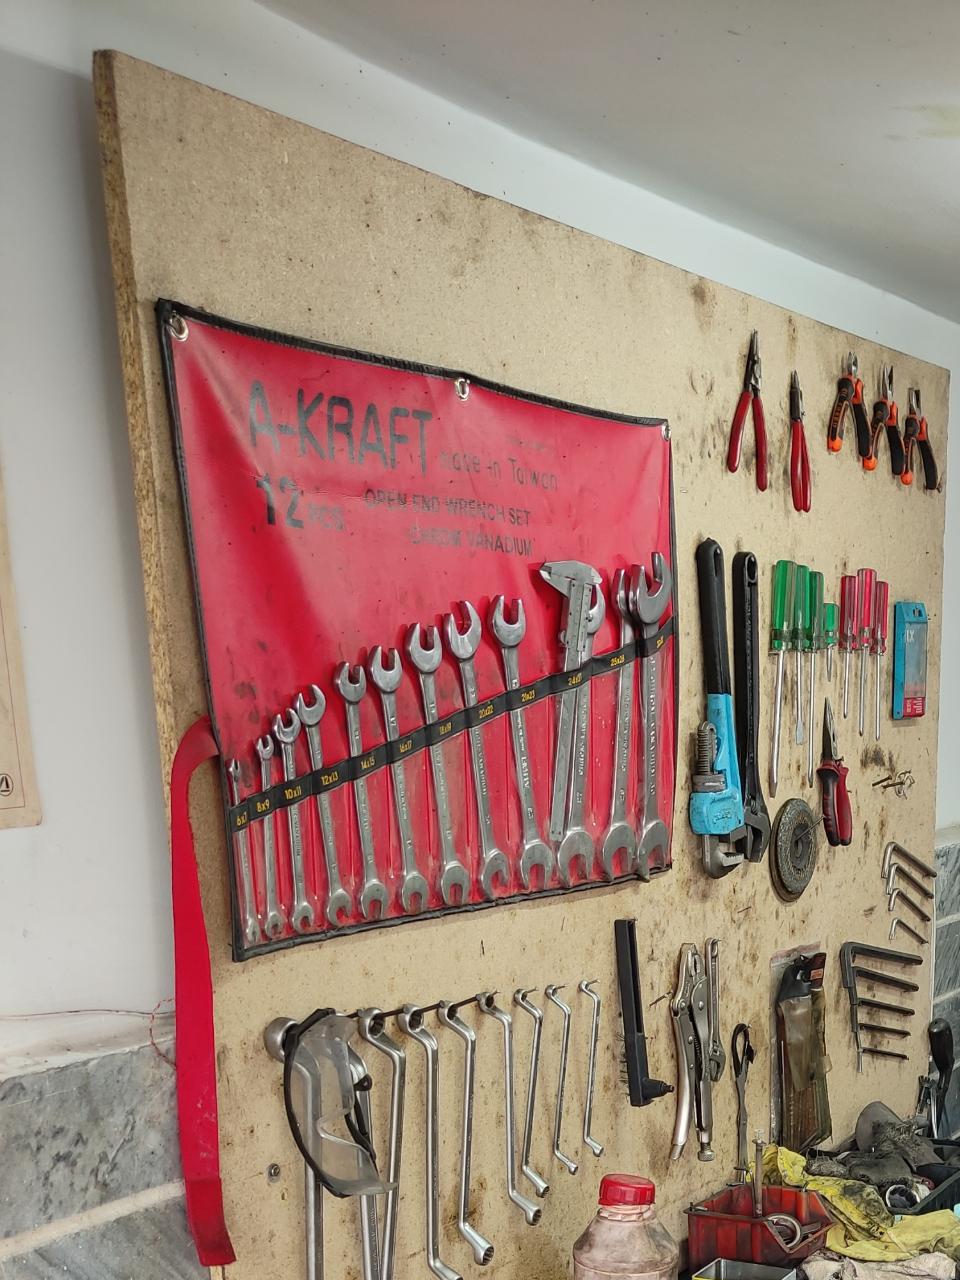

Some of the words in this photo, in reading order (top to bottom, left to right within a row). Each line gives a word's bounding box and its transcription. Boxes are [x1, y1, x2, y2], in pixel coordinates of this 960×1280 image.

[249, 379, 433, 476] A-KRAFT
[508, 457, 558, 494] Taiwan
[256, 472, 304, 527] 12
[364, 487, 407, 509] OPEN
[412, 493, 440, 513] END
[445, 497, 504, 520] WRENCH
[508, 506, 531, 525] SET
[463, 528, 533, 557] VANADIUM
[400, 740, 412, 753] 16x17
[360, 757, 376, 770] 14x15
[320, 771, 339, 785] 12x13
[284, 785, 302, 800] 10x11
[256, 799, 270, 813] 8x9
[236, 812, 248, 827] 6x7
